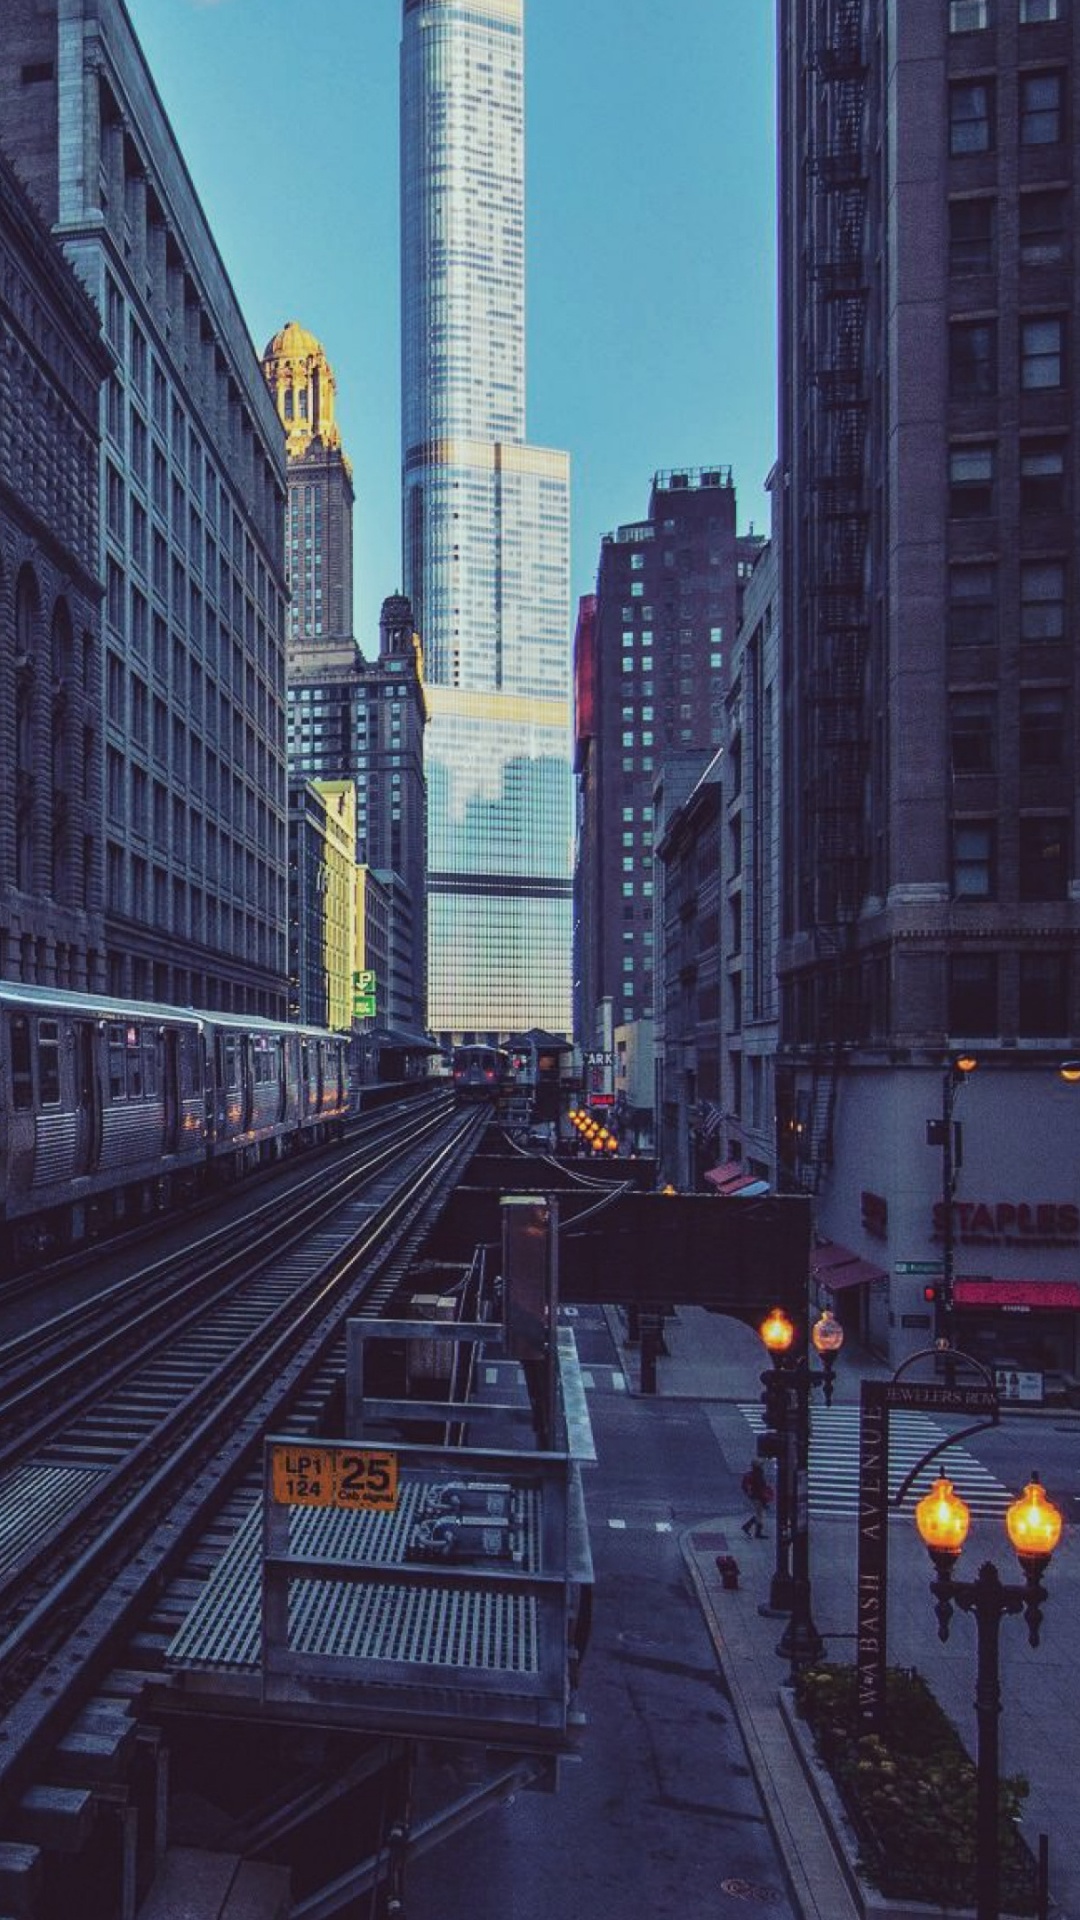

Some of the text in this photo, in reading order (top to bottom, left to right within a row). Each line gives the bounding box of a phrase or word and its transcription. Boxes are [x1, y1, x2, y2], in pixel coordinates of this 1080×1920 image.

[585, 1053, 612, 1064] ARK
[933, 1203, 1079, 1233] STAPLES
[285, 1456, 321, 1475] LP1
[341, 1457, 391, 1491] 25
[286, 1480, 322, 1496] 124
[859, 1405, 882, 1705] WABASH AVENUE
